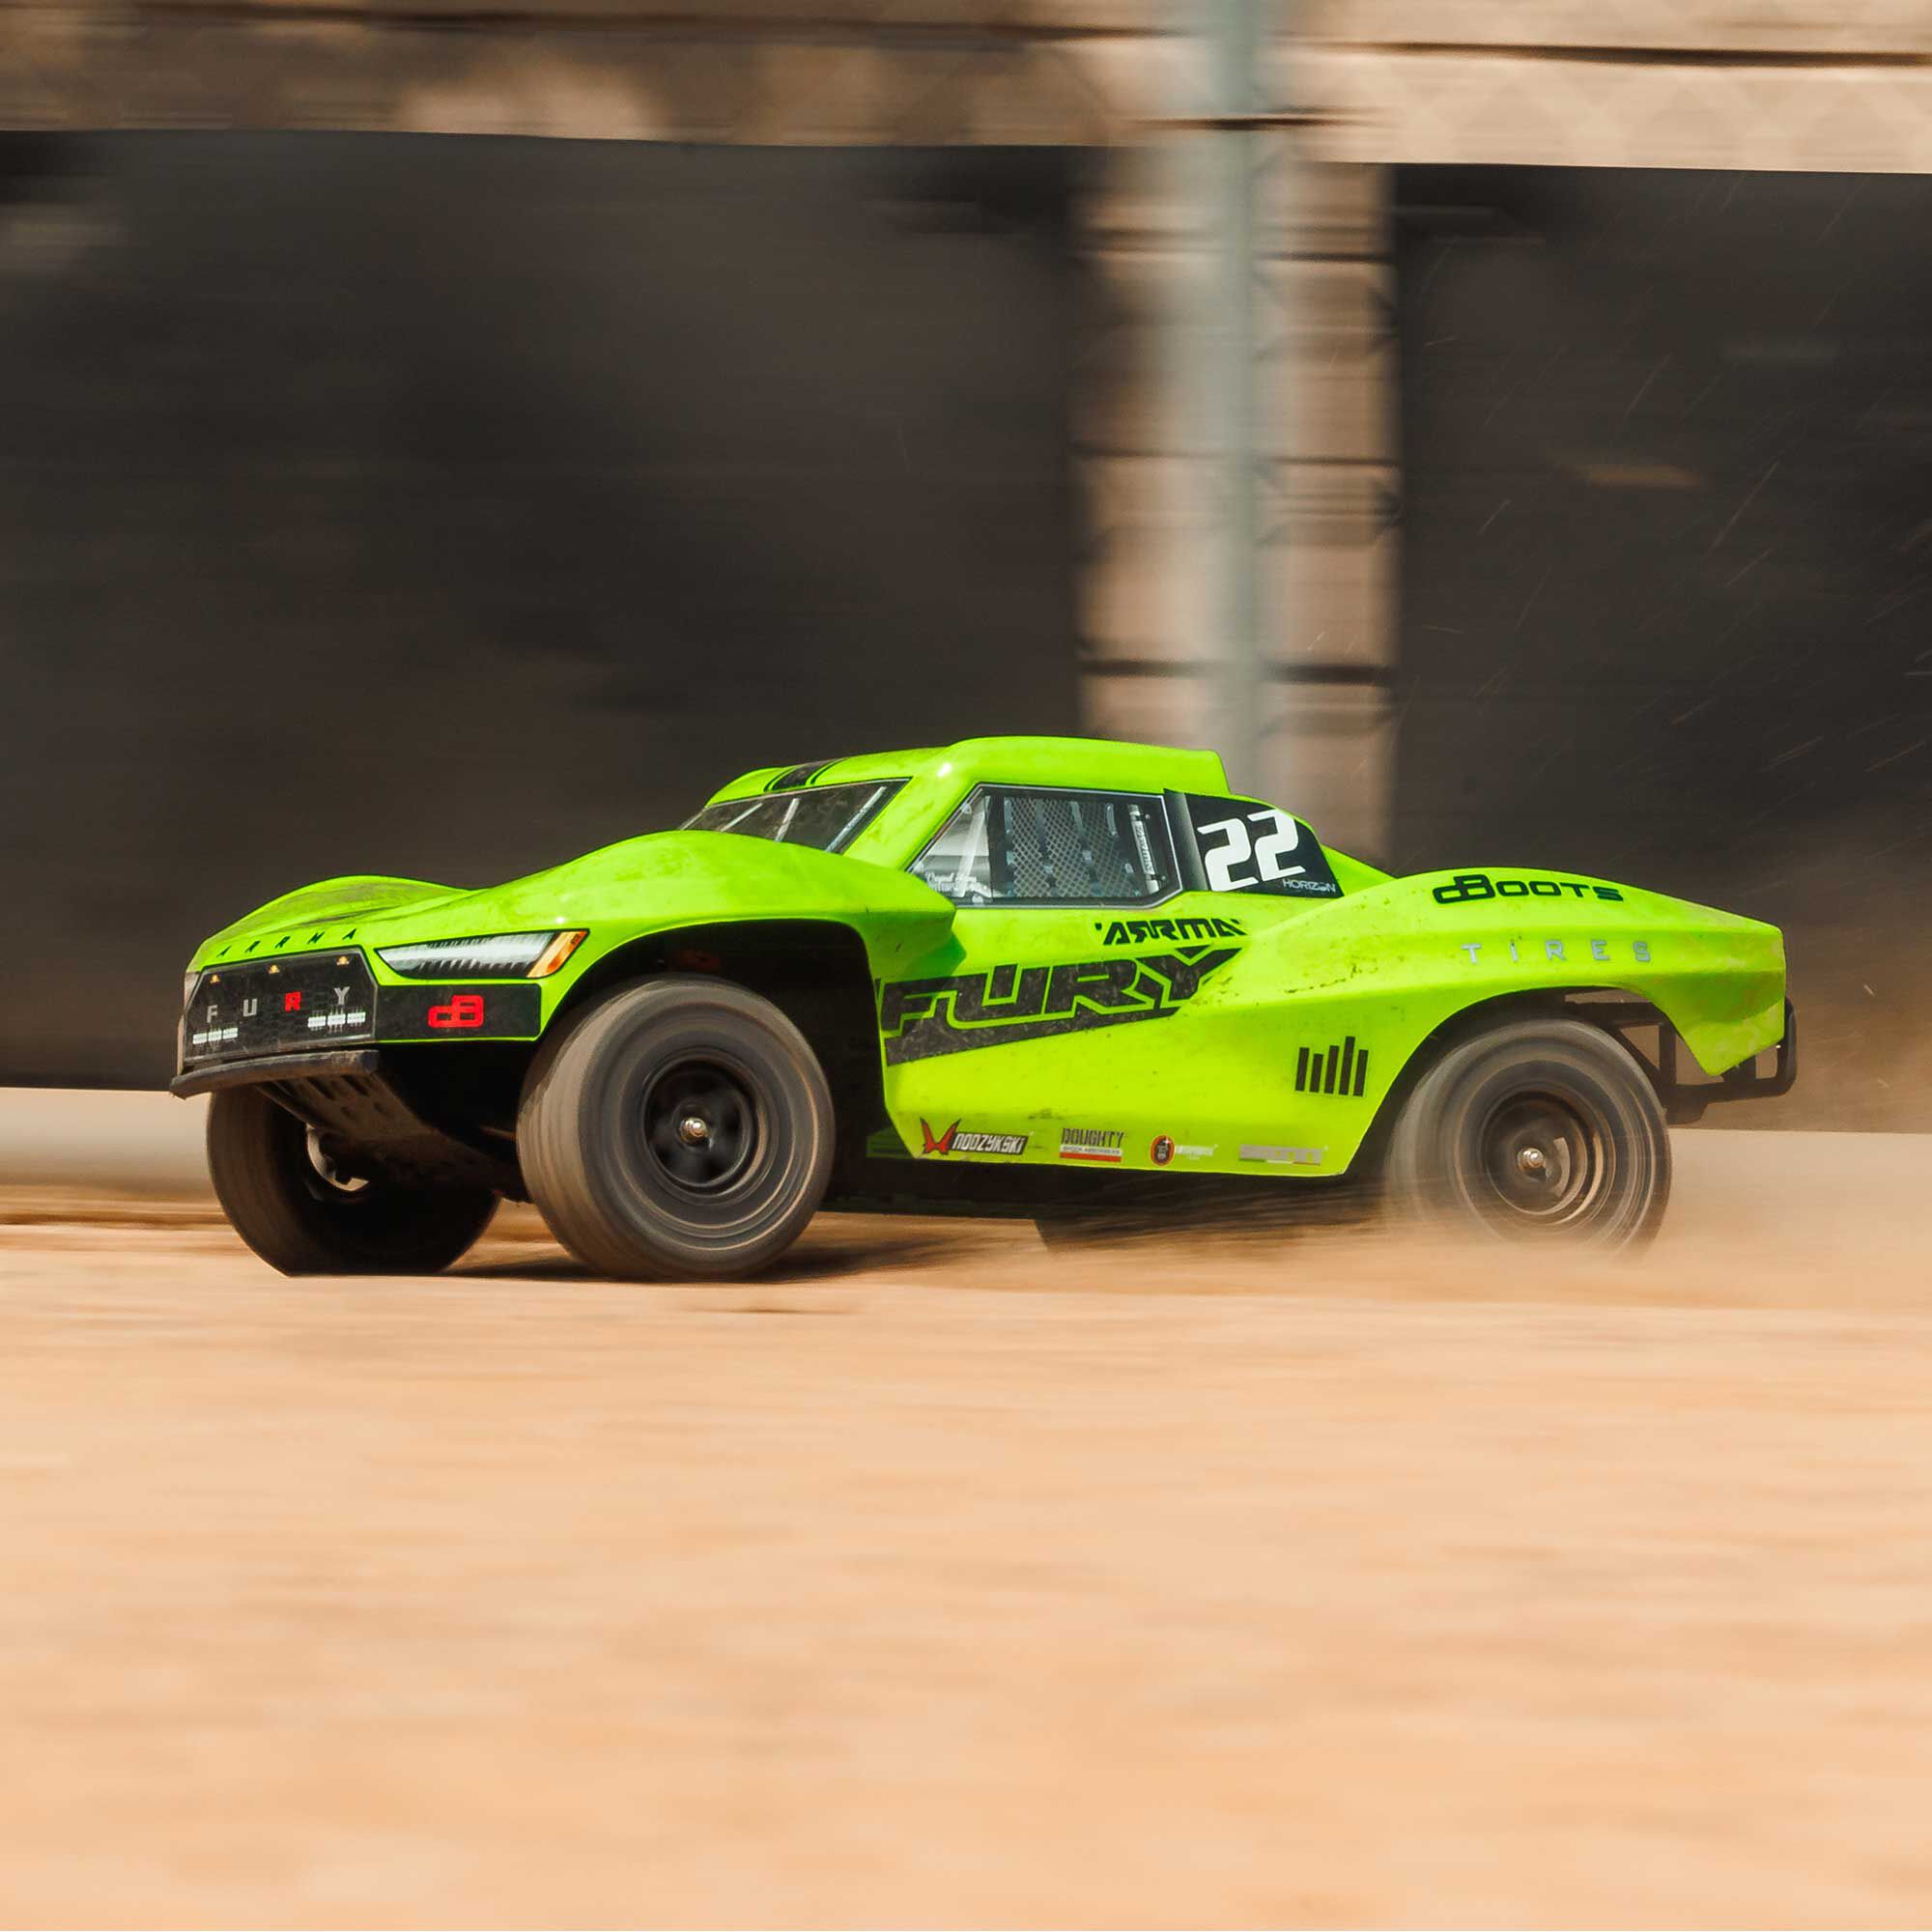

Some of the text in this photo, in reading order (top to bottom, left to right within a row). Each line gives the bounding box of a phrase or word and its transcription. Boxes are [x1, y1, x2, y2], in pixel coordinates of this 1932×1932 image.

[1197, 810, 1306, 892] 22
[1282, 878, 1337, 893] HORIZON
[1461, 940, 1651, 964] TIRES
[881, 945, 1243, 1031] FURY
[207, 986, 351, 1024] FURY
[1061, 1127, 1124, 1148] DOUGHTY
